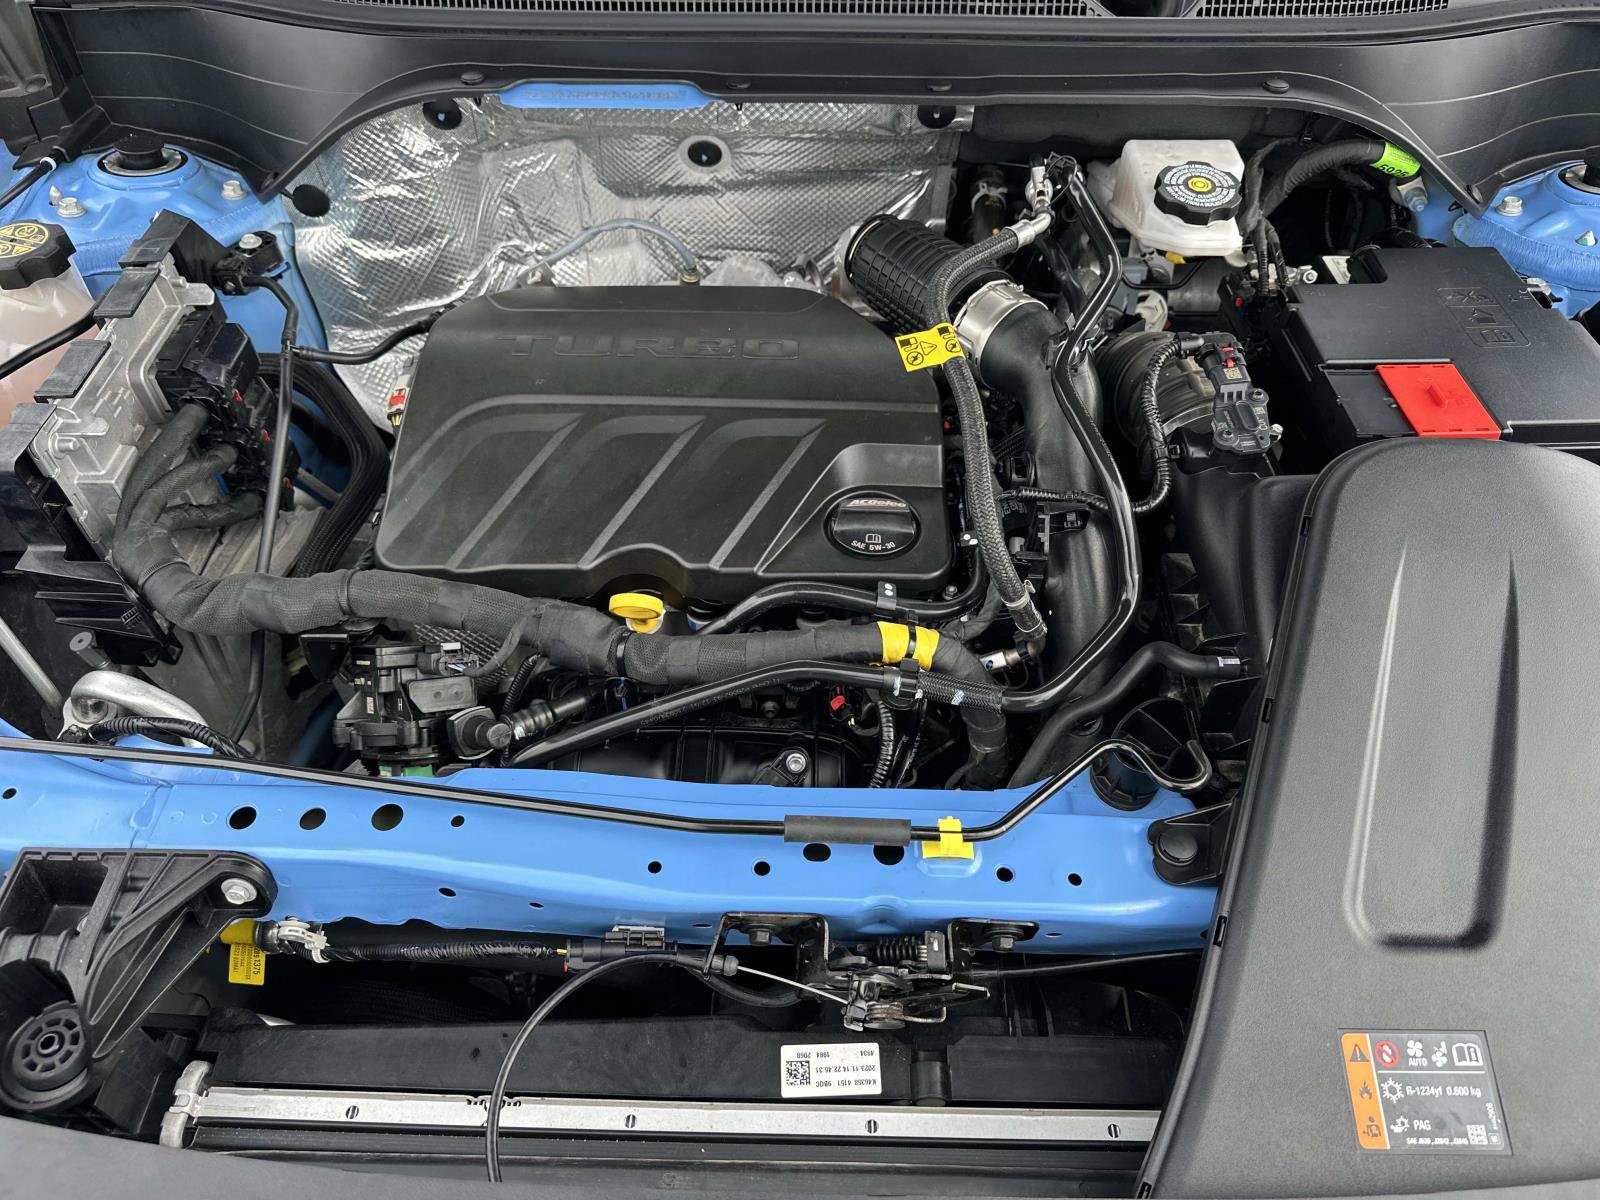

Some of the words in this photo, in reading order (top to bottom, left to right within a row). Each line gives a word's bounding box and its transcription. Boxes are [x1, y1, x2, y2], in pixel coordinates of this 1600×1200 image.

[496, 335, 799, 359] TURBO
[847, 499, 907, 508] ACDelco
[850, 540, 867, 551] SAE
[869, 541, 896, 551] 5W-30
[1408, 1057, 1428, 1067] AUTO
[1405, 1085, 1442, 1098] R-1234yf
[1446, 1086, 1469, 1096] 0.600
[1470, 1086, 1482, 1098] kg
[1413, 1120, 1431, 1130] PAG
